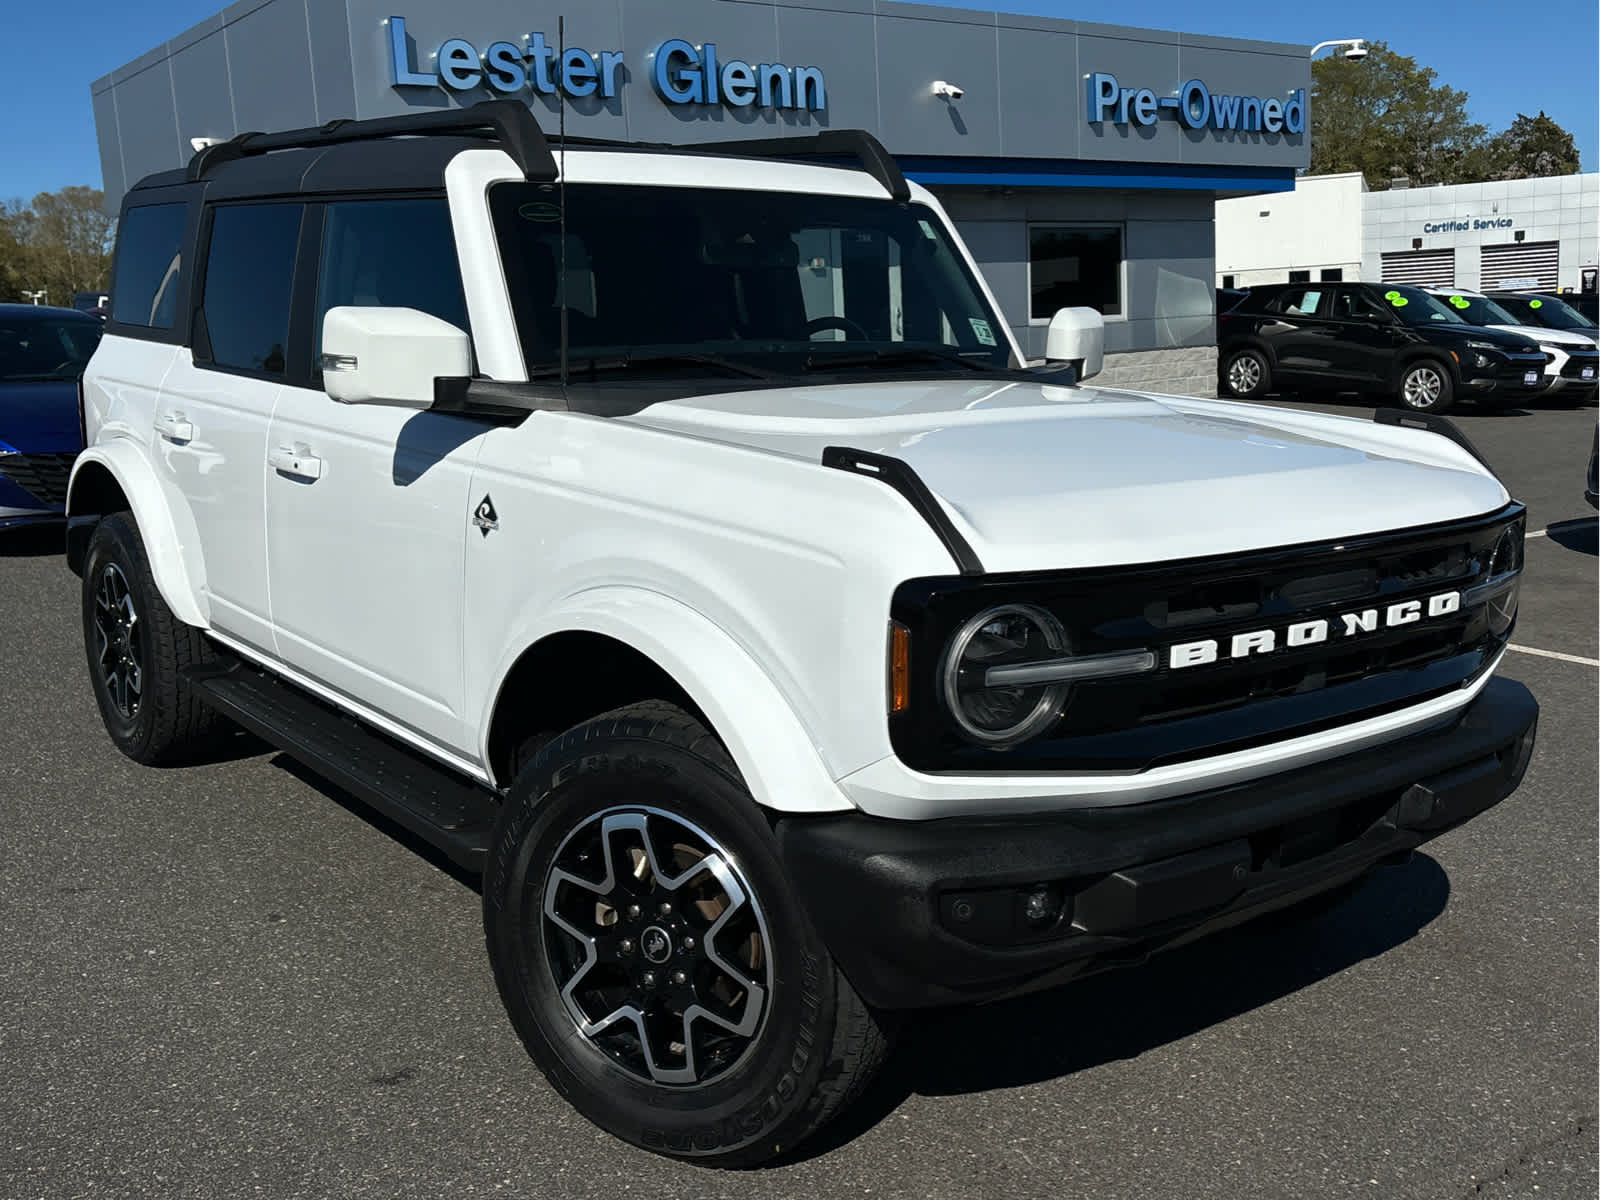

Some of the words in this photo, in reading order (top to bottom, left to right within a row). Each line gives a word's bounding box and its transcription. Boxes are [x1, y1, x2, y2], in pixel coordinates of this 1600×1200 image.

[386, 16, 624, 97] Lester
[650, 38, 825, 111] Glenn
[1087, 72, 1305, 134] Pre-Owned
[1424, 220, 1470, 233] Certified
[1473, 217, 1513, 229] Service
[1170, 591, 1461, 669] BRONCO
